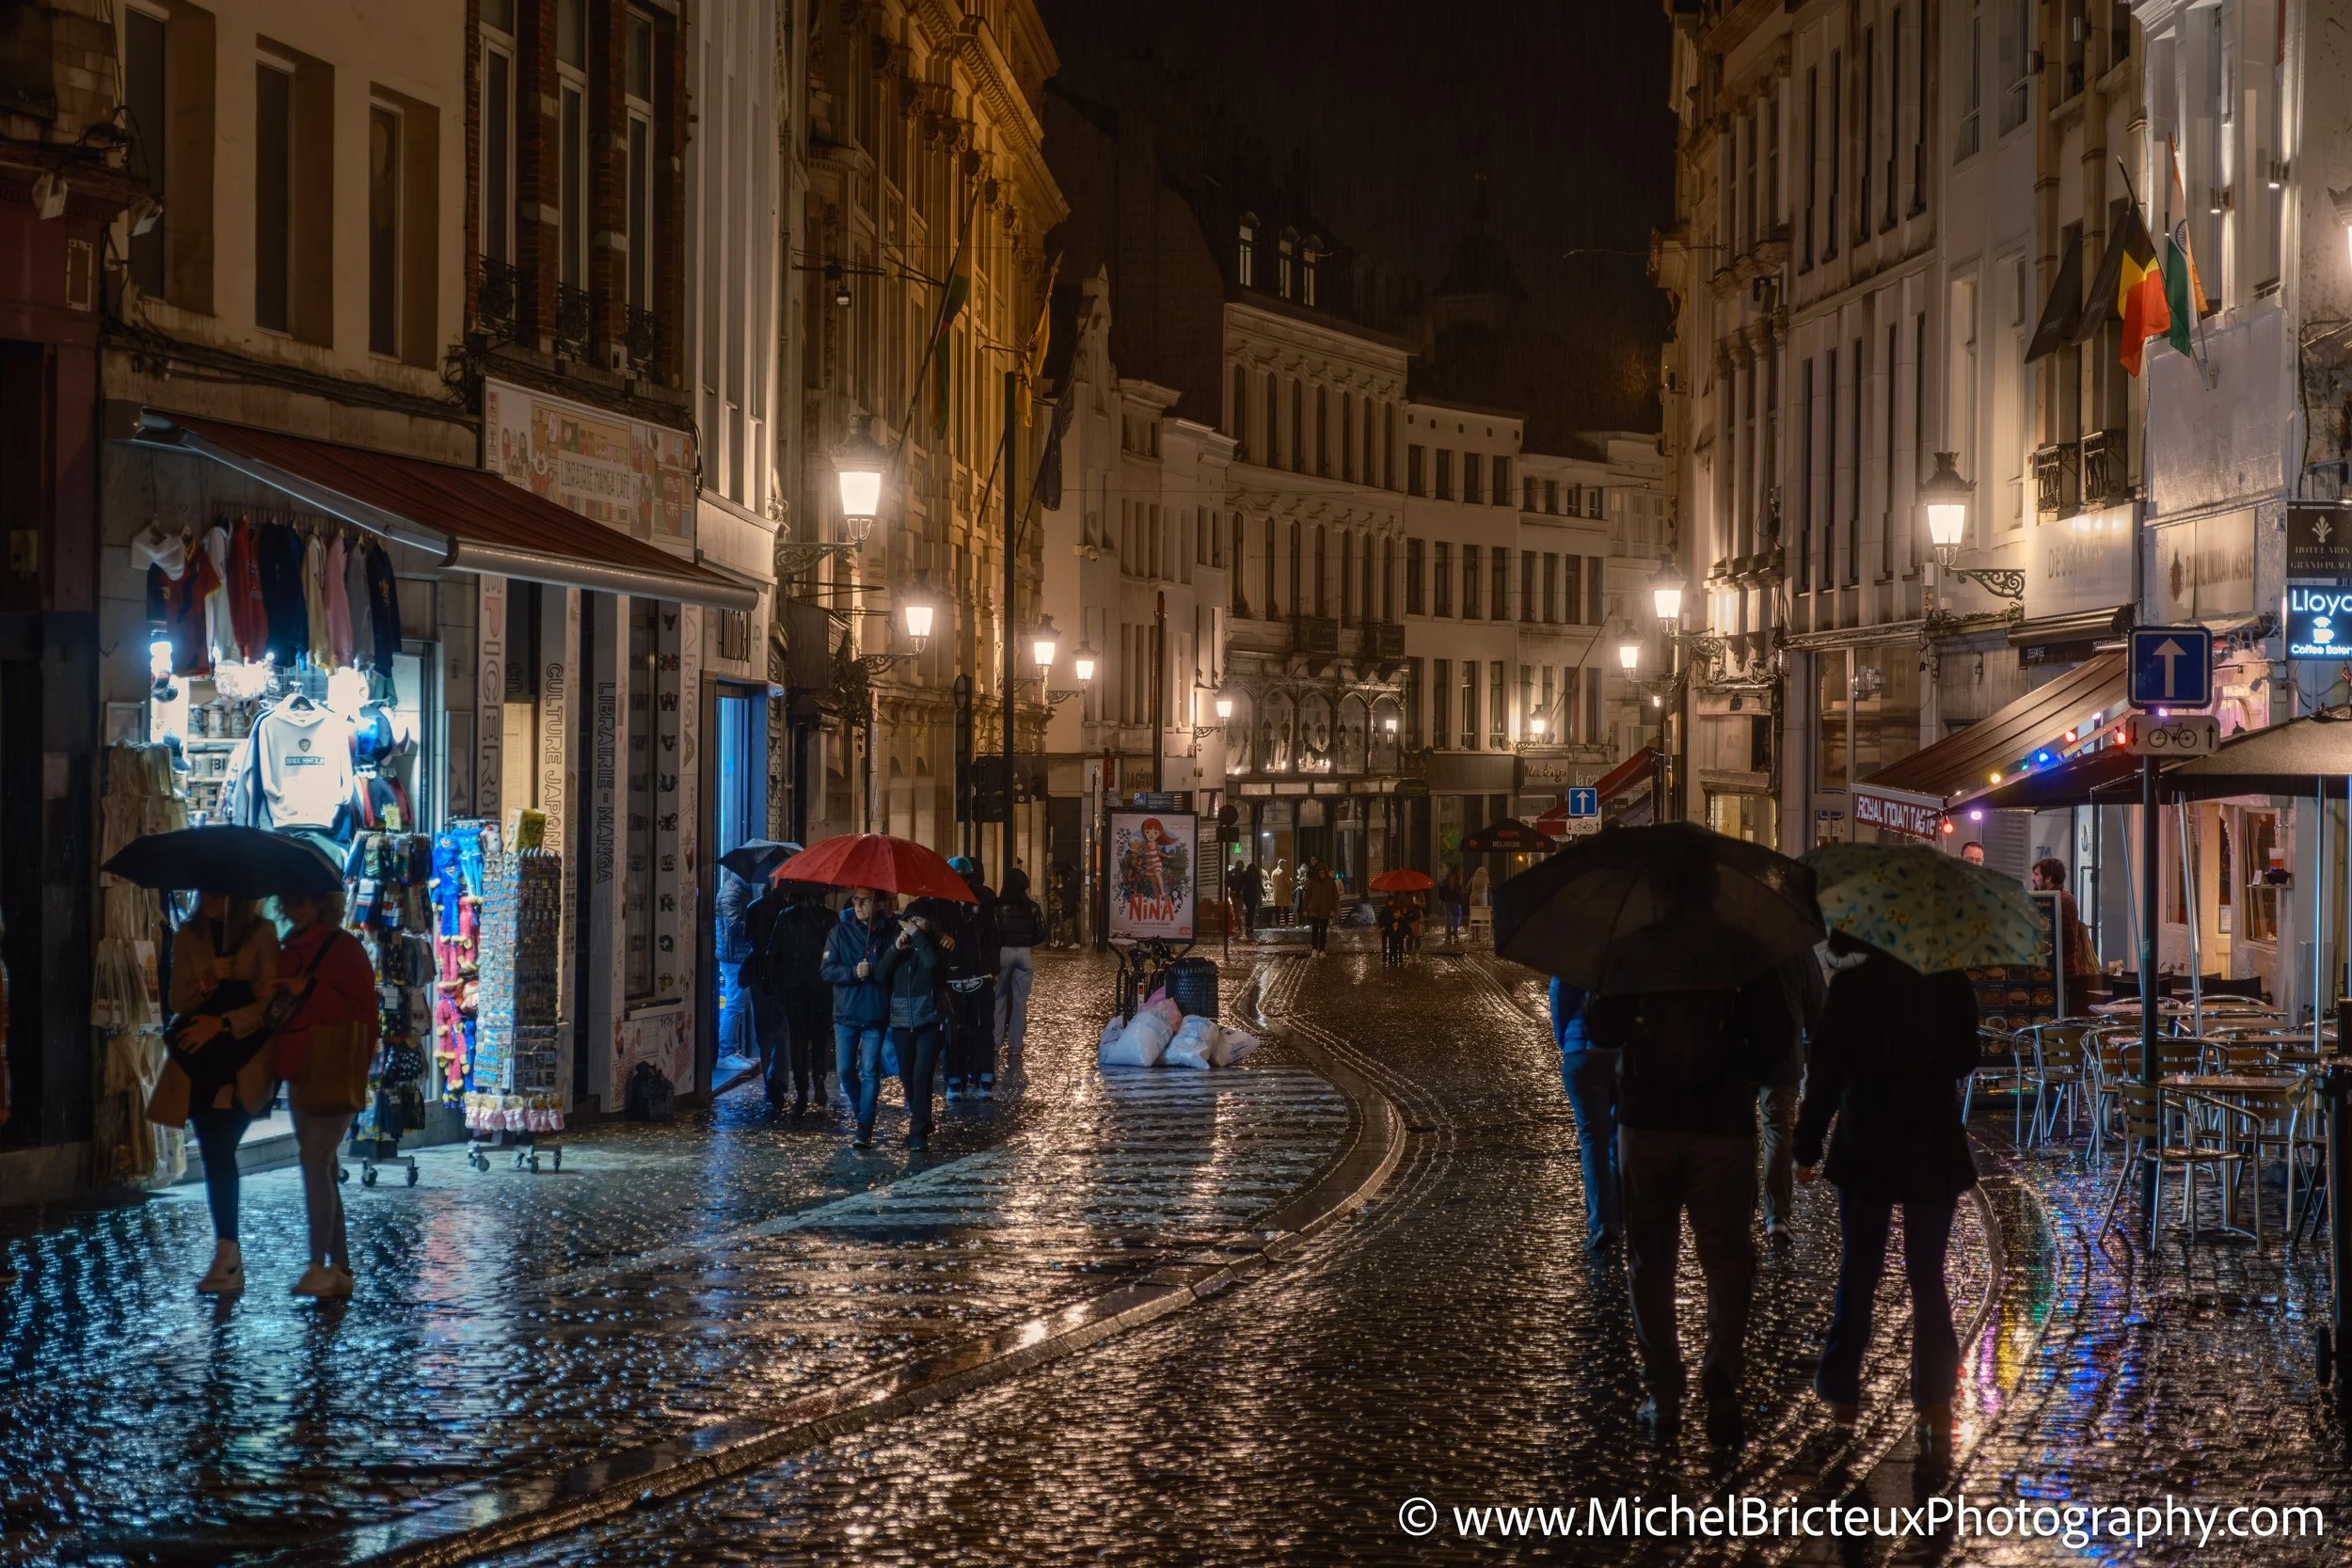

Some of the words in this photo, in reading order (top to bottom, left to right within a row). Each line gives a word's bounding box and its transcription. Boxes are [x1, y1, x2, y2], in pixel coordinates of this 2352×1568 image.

[561, 460, 593, 492] LIBRAIRIE
[2290, 561, 2324, 569] GRAND
[2295, 546, 2325, 554] HOTEL
[2292, 644, 2325, 655] Coffee
[683, 604, 697, 768] ANGA
[544, 663, 564, 765] CULTURE
[597, 682, 615, 789] LIBRAIRIE
[1856, 796, 1883, 823] ROYAL
[596, 806, 614, 884] MANGA
